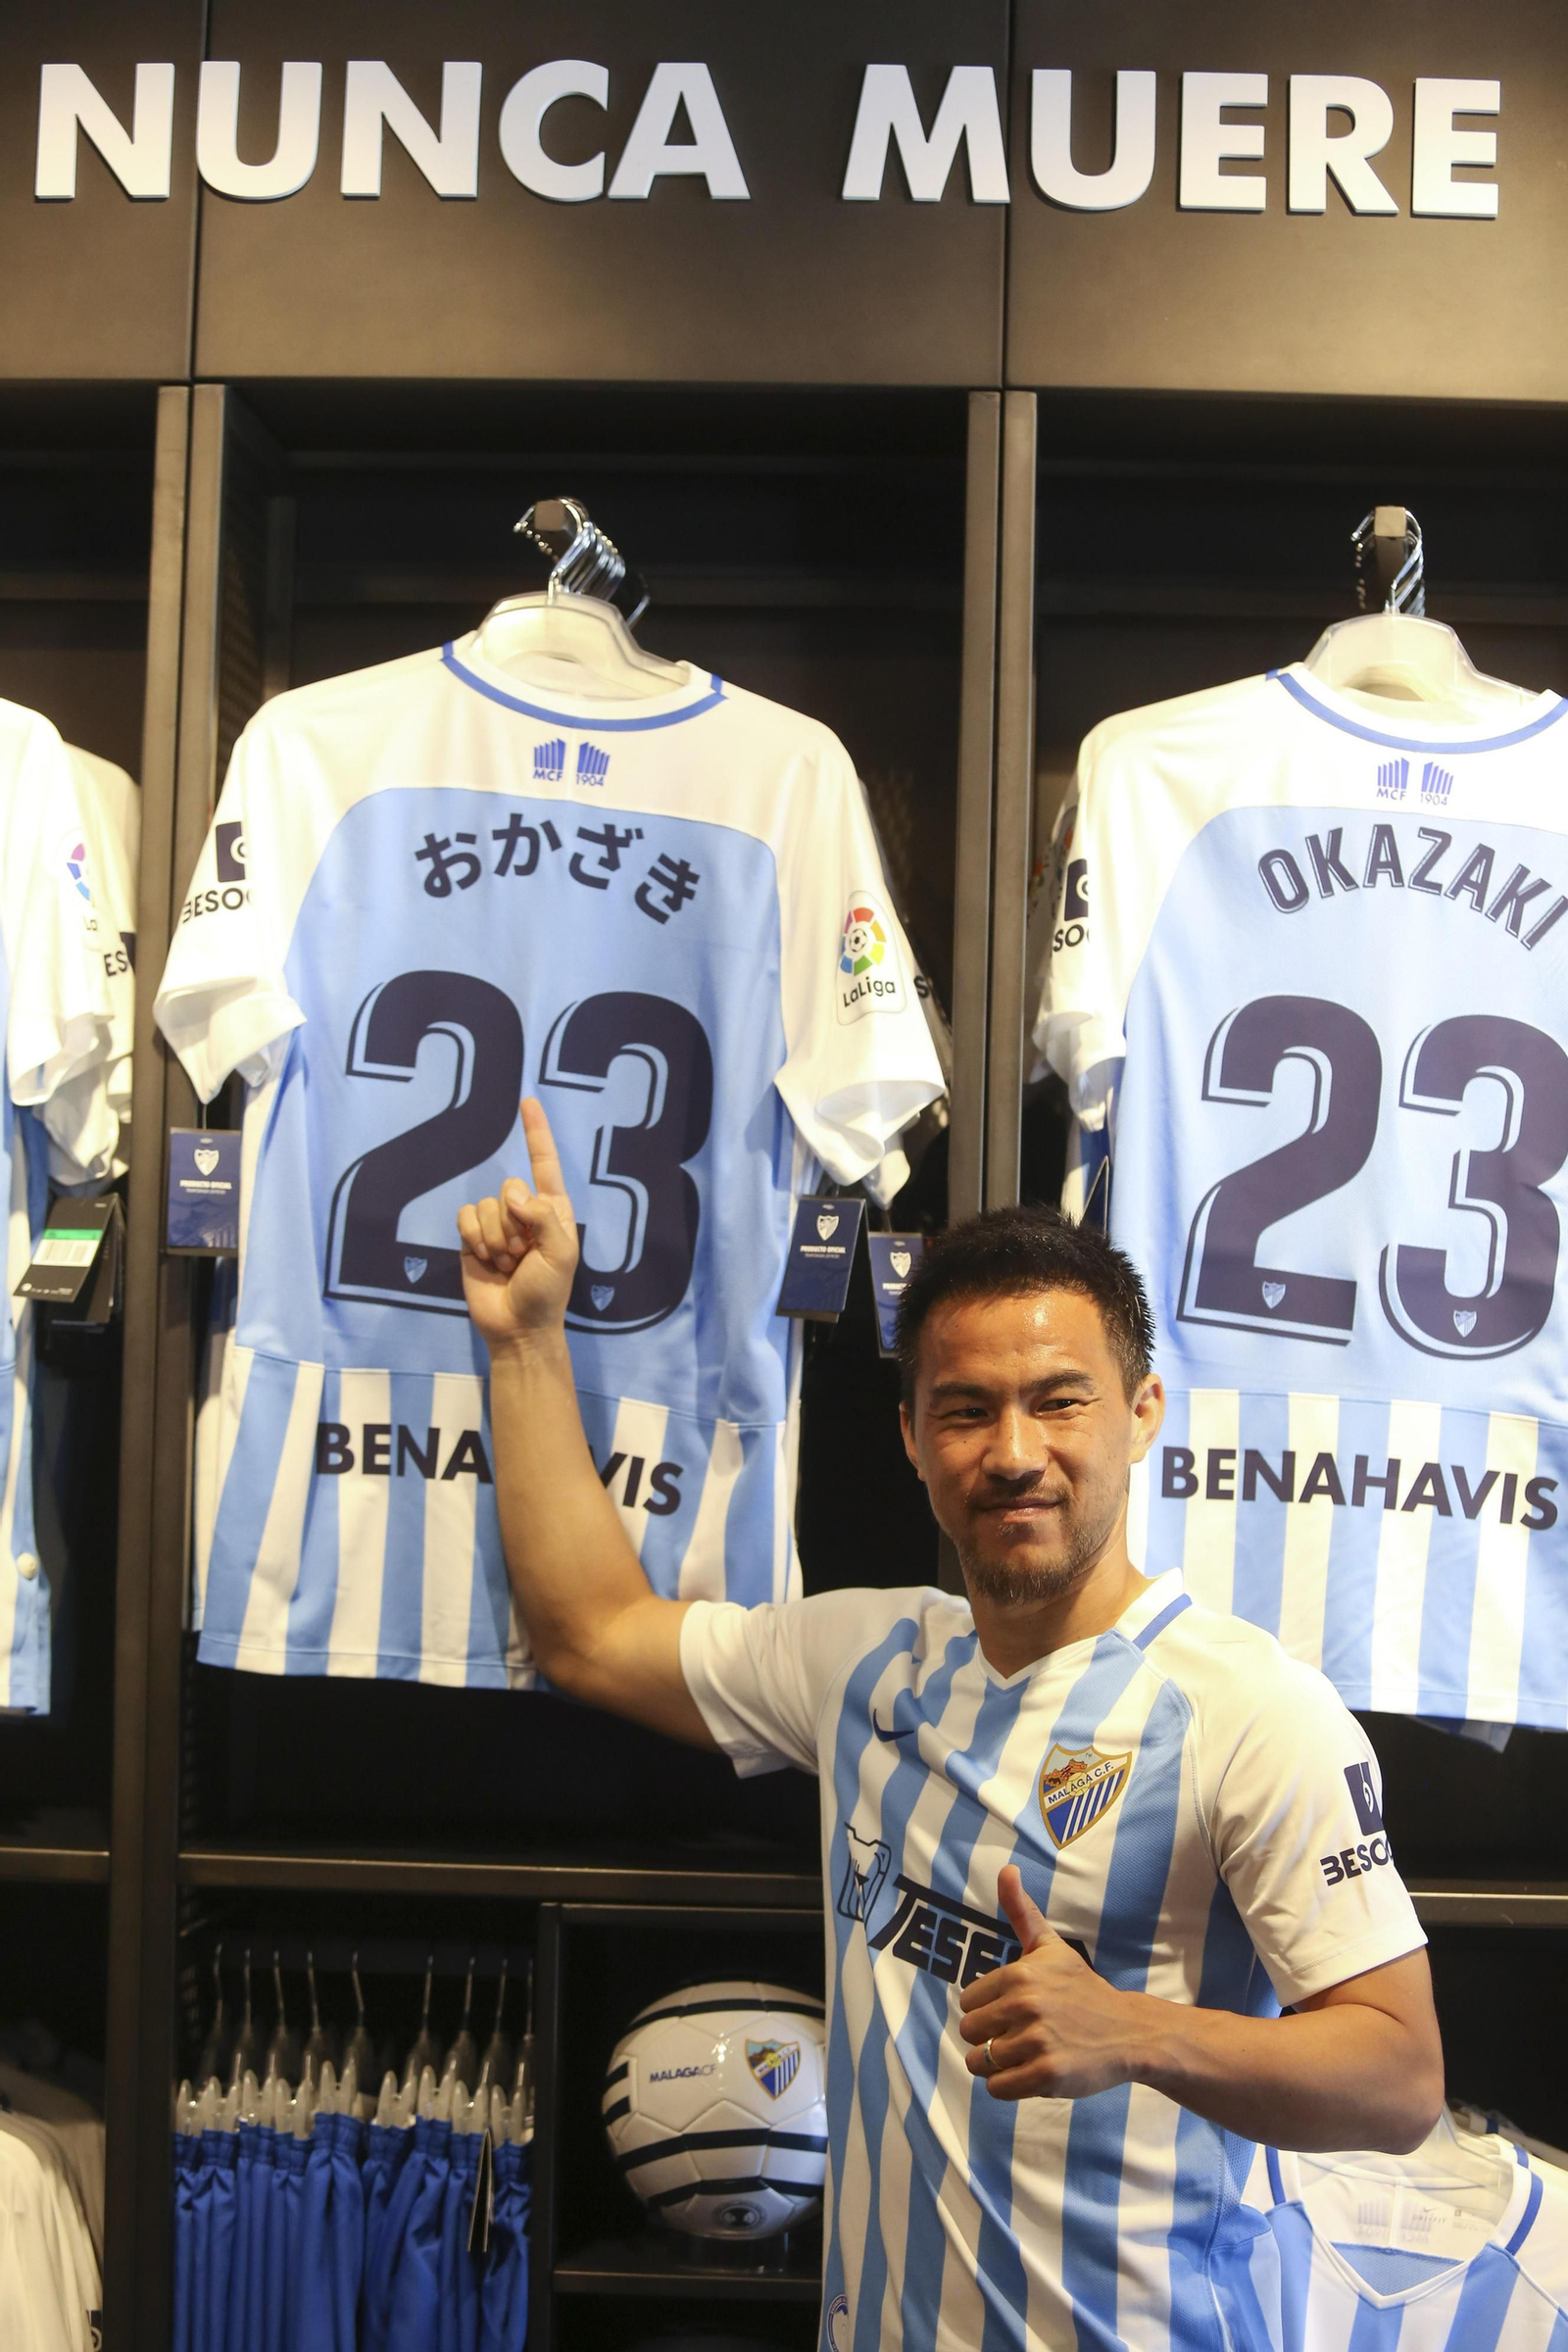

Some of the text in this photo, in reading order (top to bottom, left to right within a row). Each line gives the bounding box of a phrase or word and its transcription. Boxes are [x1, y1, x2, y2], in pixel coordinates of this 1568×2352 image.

[35, 59, 1500, 219] NUNCA MUERE
[533, 769, 605, 787] MCF 1904
[1376, 787, 1447, 806] MCF 1904
[181, 887, 252, 924] BESO
[415, 812, 701, 925] おかざき
[1257, 824, 1568, 951] OKAZAKI
[843, 976, 897, 1008] LaLiga
[322, 969, 713, 1336] 23
[1176, 994, 1568, 1361] 23
[1161, 1446, 1559, 1531] BENAHAVIS
[1048, 1761, 1114, 1804] MALAGA C.F.
